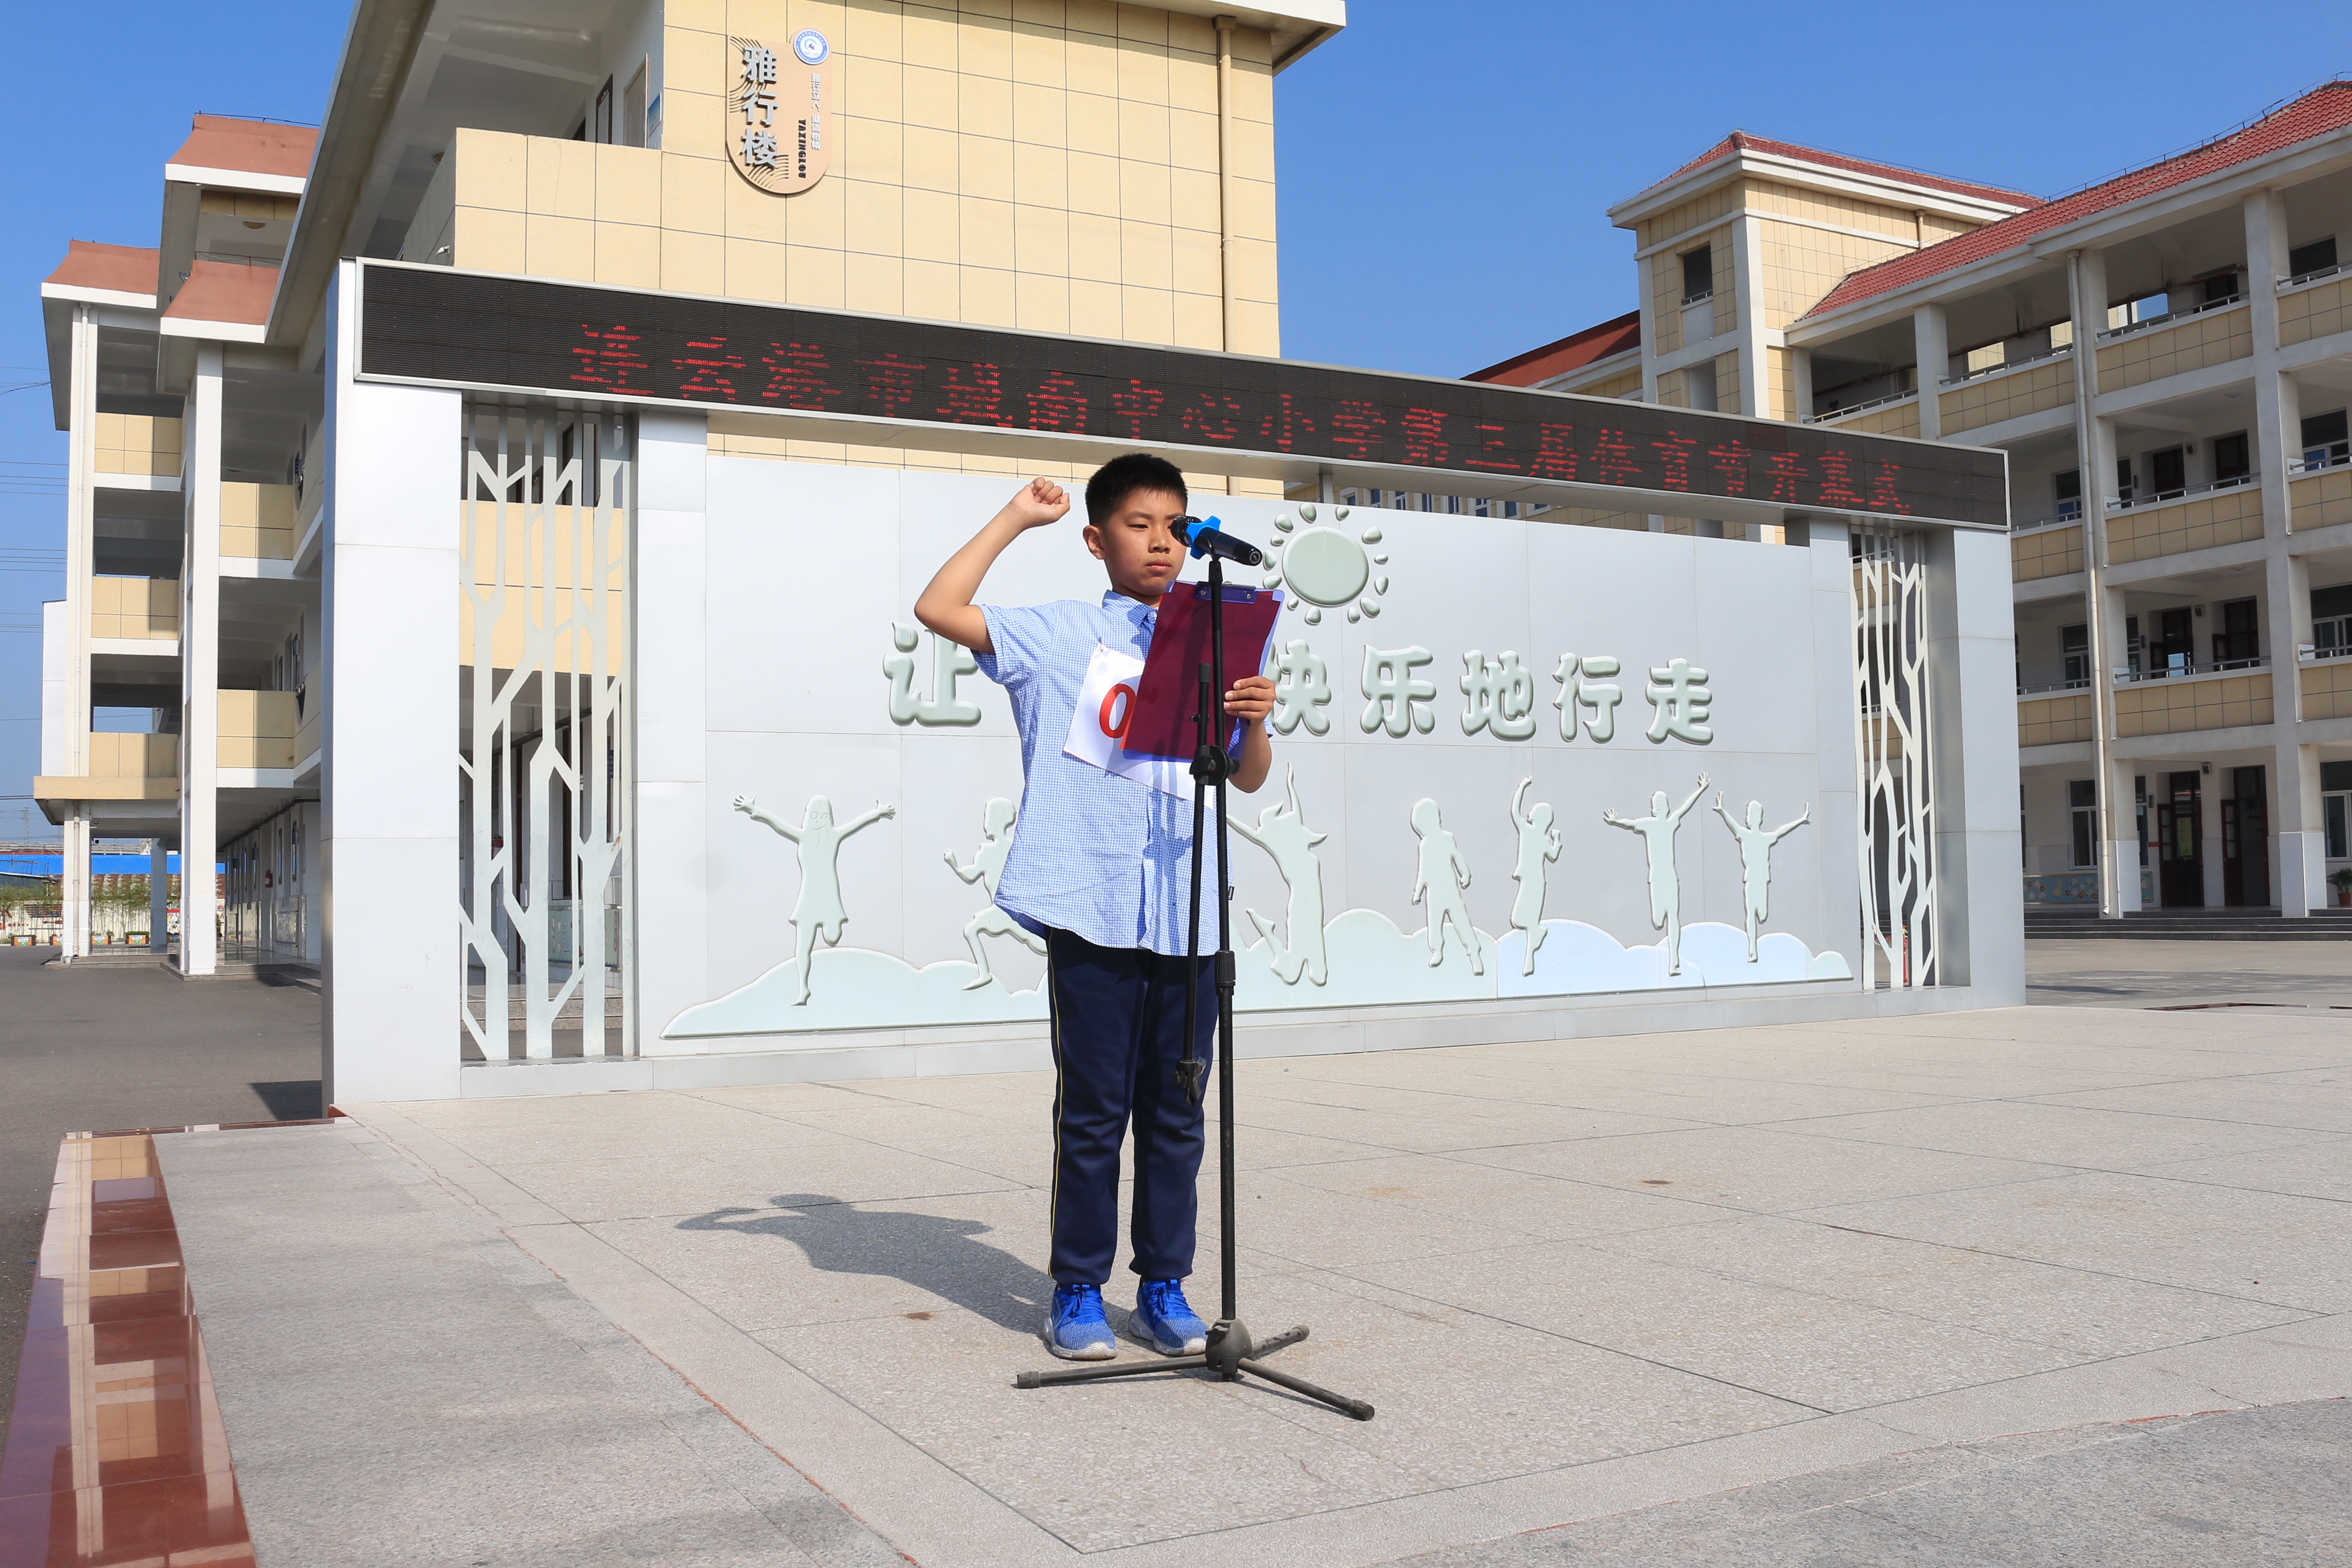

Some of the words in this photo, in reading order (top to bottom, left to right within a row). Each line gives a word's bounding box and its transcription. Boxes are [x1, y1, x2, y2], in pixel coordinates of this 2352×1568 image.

[741, 46, 779, 169] 雅行楼
[798, 119, 806, 179] YAXINGLOU
